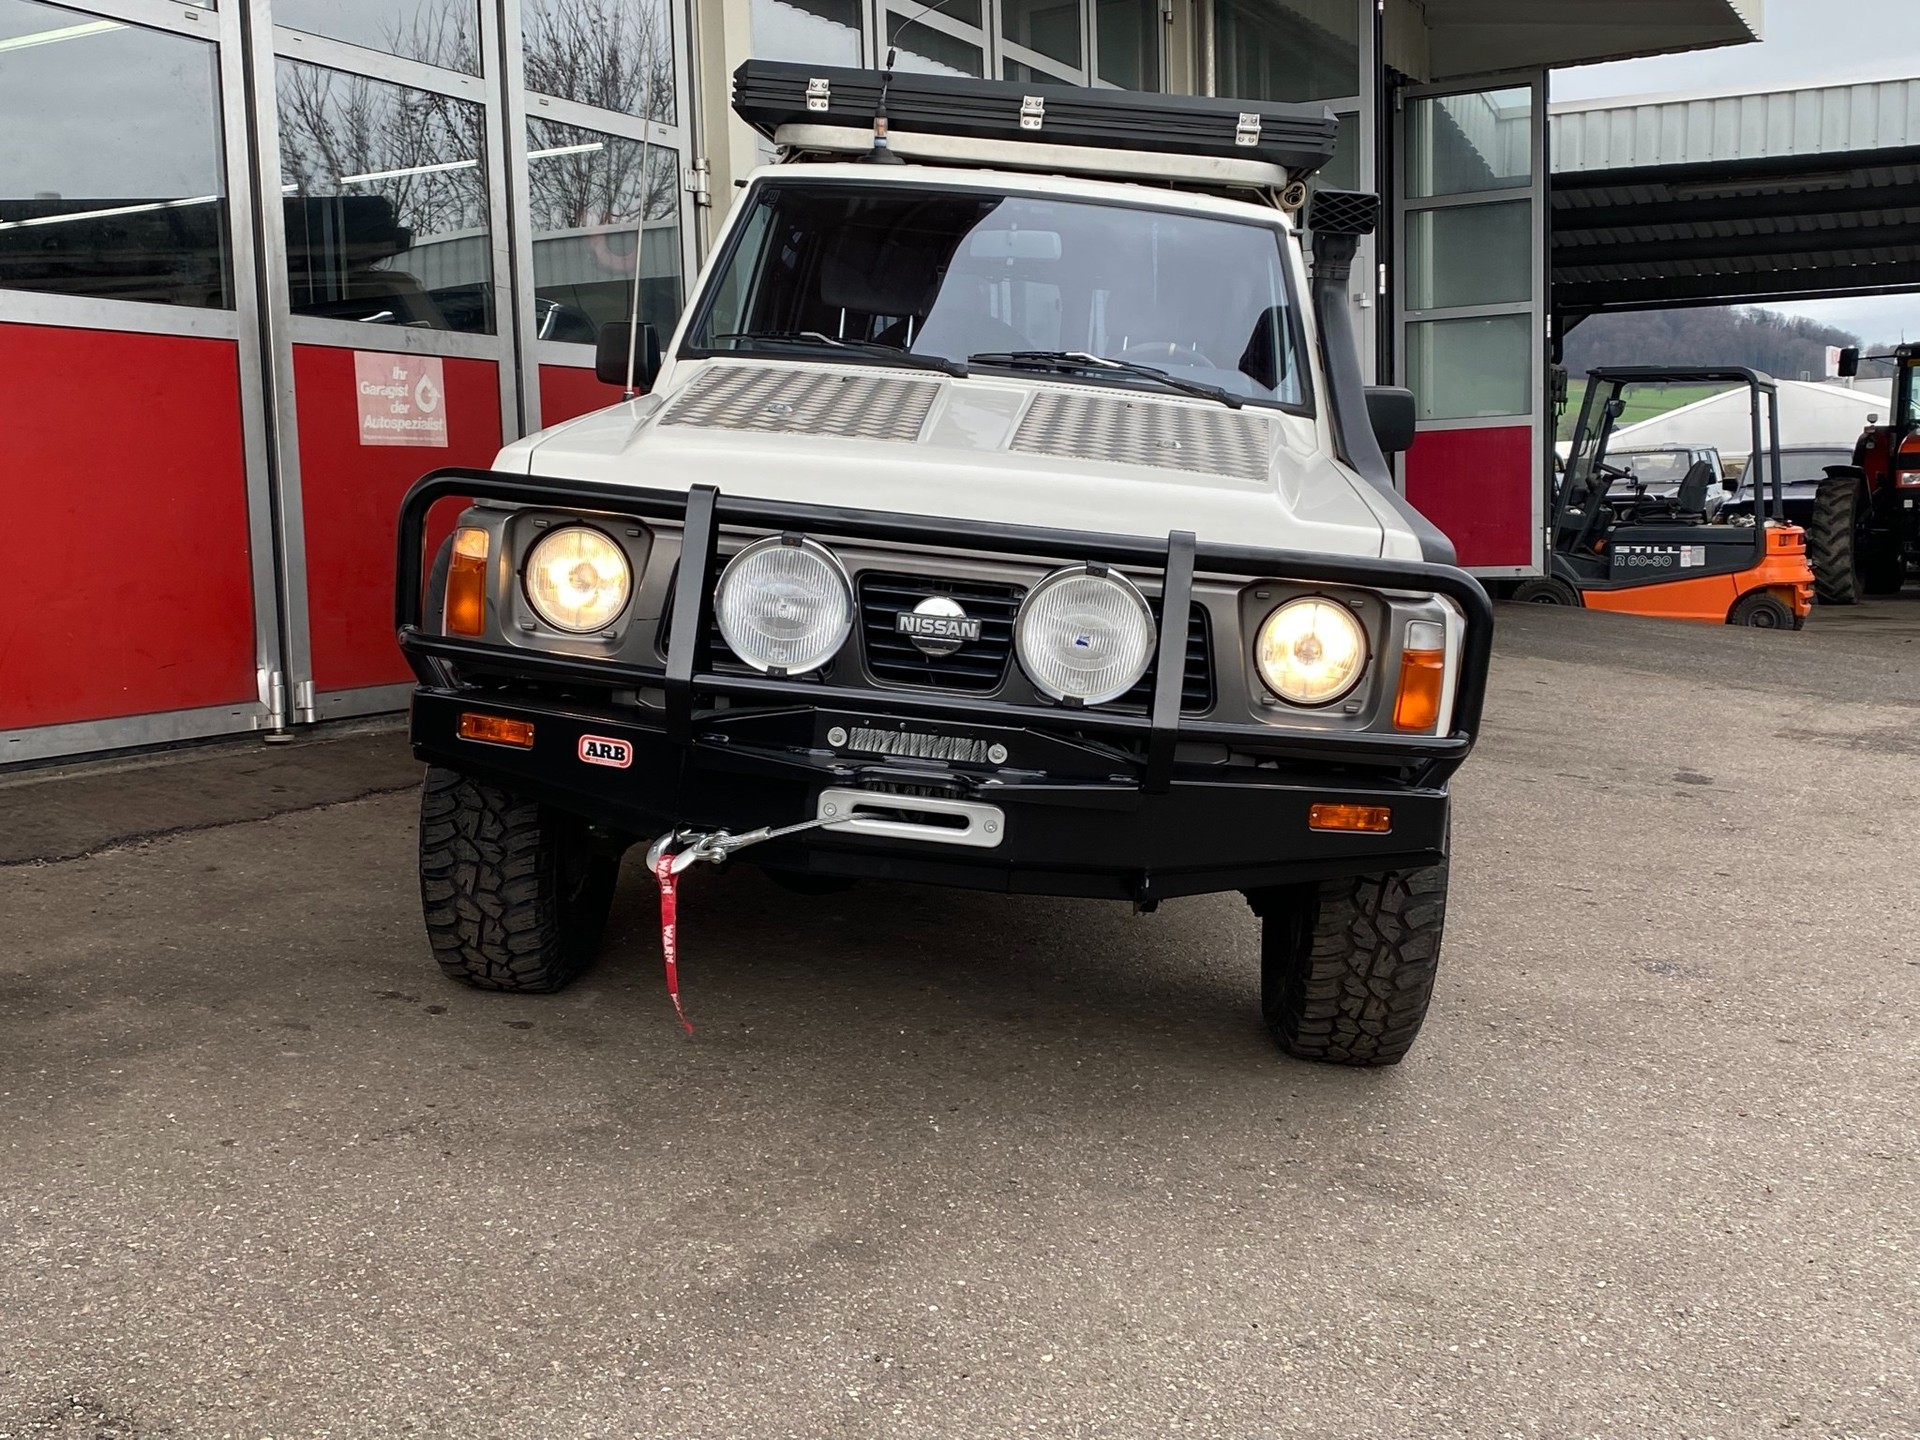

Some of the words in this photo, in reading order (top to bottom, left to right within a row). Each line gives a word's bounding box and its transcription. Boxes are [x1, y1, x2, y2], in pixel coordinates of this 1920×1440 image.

[392, 366, 408, 380] Ihr
[360, 381, 409, 399] Garagist
[390, 400, 410, 414] der
[363, 415, 443, 432] Autospezialist
[1614, 545, 1680, 554] STILL
[1614, 555, 1626, 567] R
[1627, 555, 1673, 567] 60-30
[899, 615, 977, 638] NISSAN
[585, 741, 625, 761] ARB
[663, 924, 675, 964] WARN
